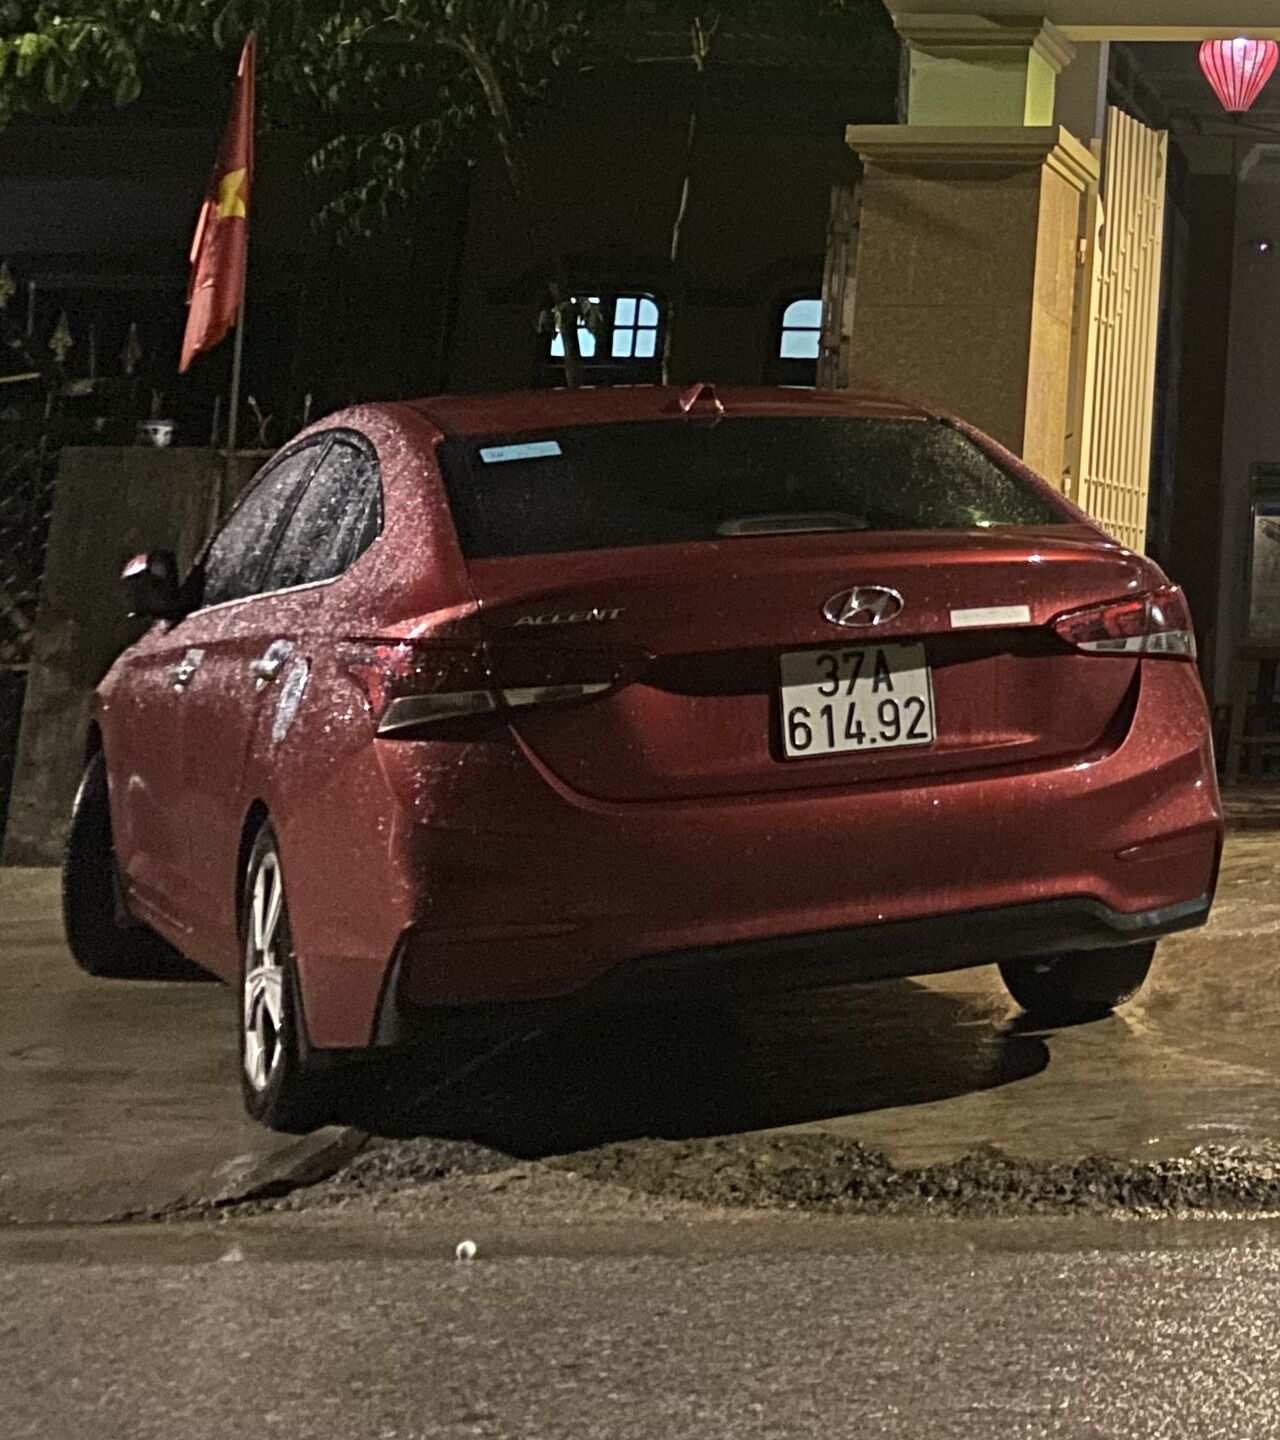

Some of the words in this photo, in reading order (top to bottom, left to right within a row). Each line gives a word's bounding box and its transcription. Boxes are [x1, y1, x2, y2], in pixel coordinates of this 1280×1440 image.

[513, 607, 626, 627] ACCENT
[815, 648, 894, 698] 37A
[787, 695, 929, 751] 614.92
